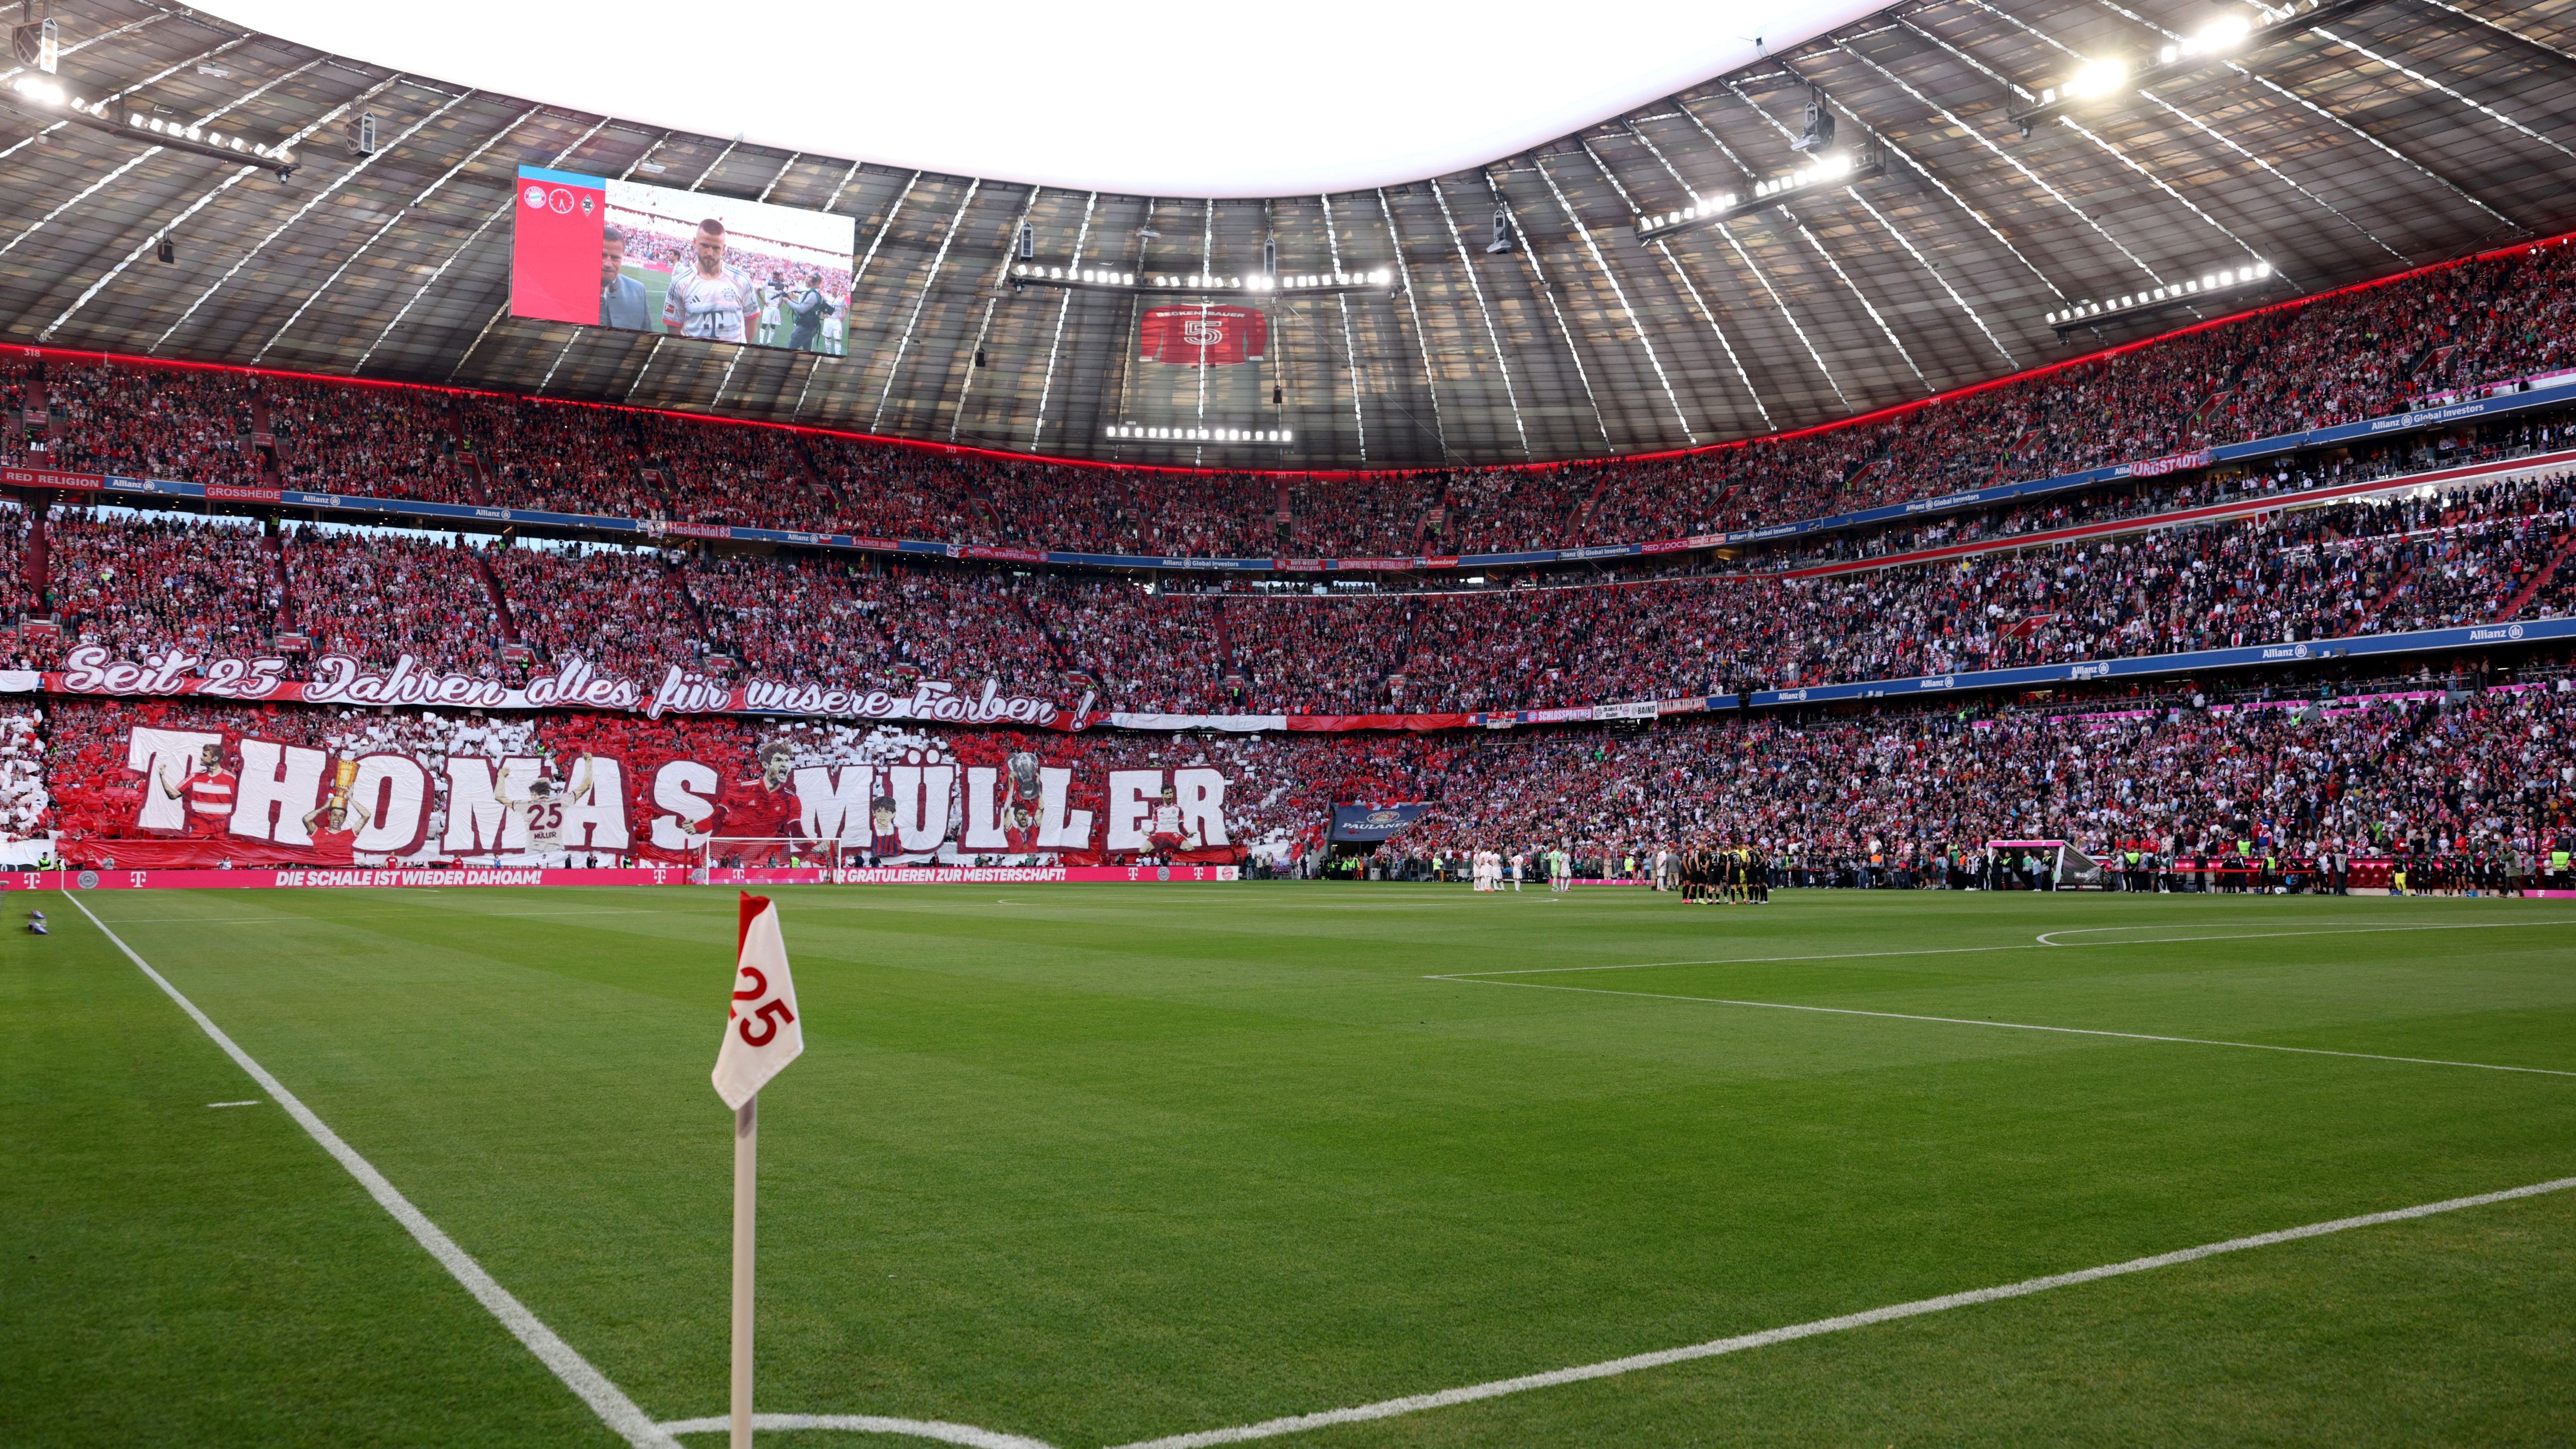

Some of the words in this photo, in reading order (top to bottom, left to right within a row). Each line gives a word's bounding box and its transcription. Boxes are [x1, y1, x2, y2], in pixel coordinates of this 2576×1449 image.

[1183, 320, 1223, 345] 5
[24, 348, 40, 358] 318
[2372, 418, 2400, 430] Allianz
[2414, 410, 2442, 422] Global
[2443, 404, 2484, 416] Investors
[2115, 467, 2130, 476] Allia
[6, 472, 32, 481] RED
[38, 476, 99, 487] RELIGION
[113, 479, 142, 488] Allianz
[207, 487, 281, 499] GROSSHEIDE
[302, 495, 329, 504] Allianz
[1906, 503, 1925, 512] Allianz
[1934, 498, 1952, 507] Global
[476, 509, 500, 517] Allianz
[669, 523, 718, 537] Haslachtal
[720, 527, 730, 538] 83
[1773, 526, 1796, 534] Investors
[788, 533, 809, 542] Allianz
[1665, 541, 1687, 549] DOCS
[2470, 627, 2507, 640] Allianz
[2262, 647, 2293, 658] Allianz
[2072, 665, 2098, 676] Allianz
[62, 643, 201, 695] Seit
[198, 657, 287, 699] 25
[303, 652, 508, 705] Jahren
[525, 654, 643, 709] alles
[647, 664, 731, 720] für
[744, 677, 894, 717] unsere
[911, 676, 1058, 727] Farben
[1921, 679, 1944, 688] Allianz
[1778, 691, 1798, 700] Allianz
[1538, 708, 1592, 721] SCHLOSSPANTHER
[128, 725, 726, 856] THOMAS
[788, 747, 1230, 856] MÜLLER
[527, 803, 562, 830] 25
[1711, 854, 1720, 864] 27
[1733, 854, 1740, 864] 26
[130, 871, 146, 887] T
[276, 871, 305, 886] DIE
[306, 871, 372, 886] SCHALE
[374, 871, 401, 885] IST
[402, 870, 465, 885] WIEDER
[466, 870, 542, 885] DAHOAM!
[654, 869, 666, 884] T
[819, 869, 846, 882] WIR
[847, 869, 935, 882] GRATULIEREN
[936, 869, 962, 882] ZUR
[963, 868, 1066, 881] MEISTERSCHAFT!
[1128, 867, 1138, 880] T
[1194, 867, 1204, 880] T
[24, 872, 40, 889] T
[731, 967, 795, 1048] 25
